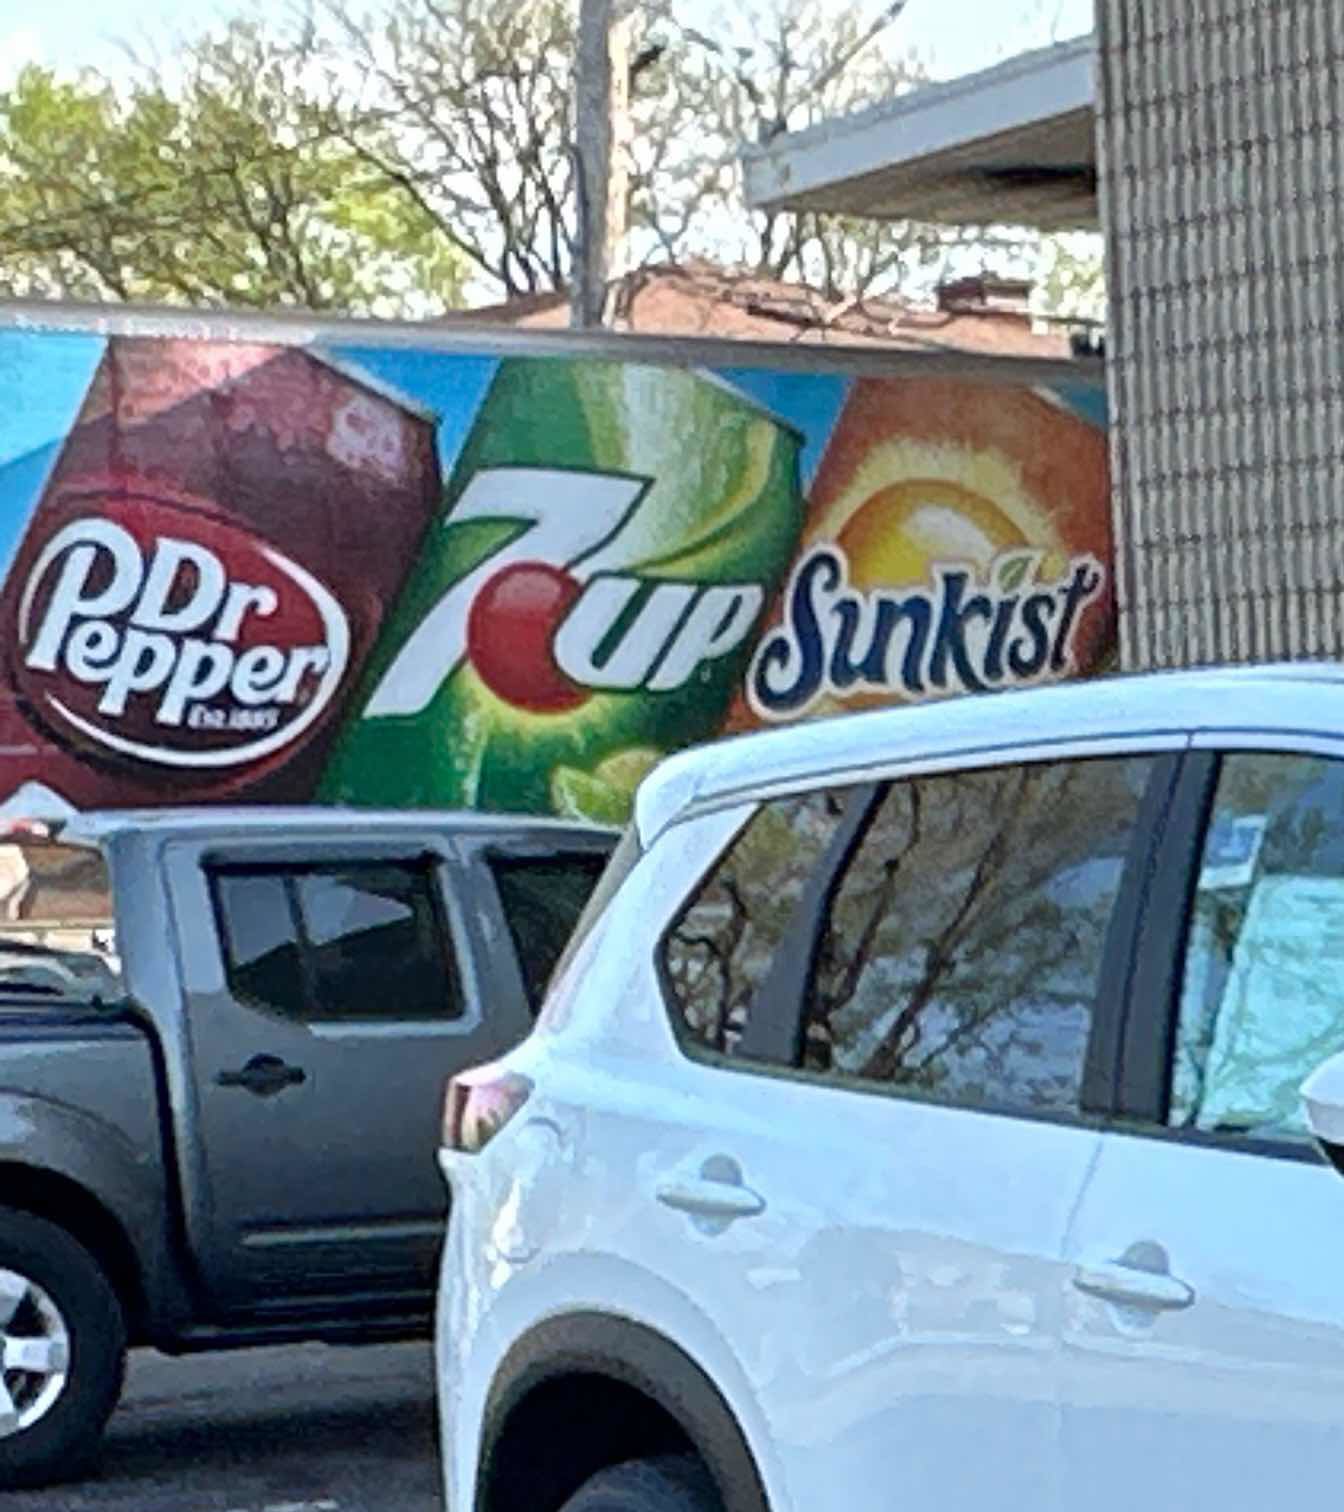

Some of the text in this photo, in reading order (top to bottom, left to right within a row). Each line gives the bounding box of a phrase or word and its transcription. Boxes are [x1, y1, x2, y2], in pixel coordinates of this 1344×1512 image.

[26, 517, 331, 725] Pepper
[130, 536, 278, 642] Dr
[755, 549, 1101, 710] Sunkist
